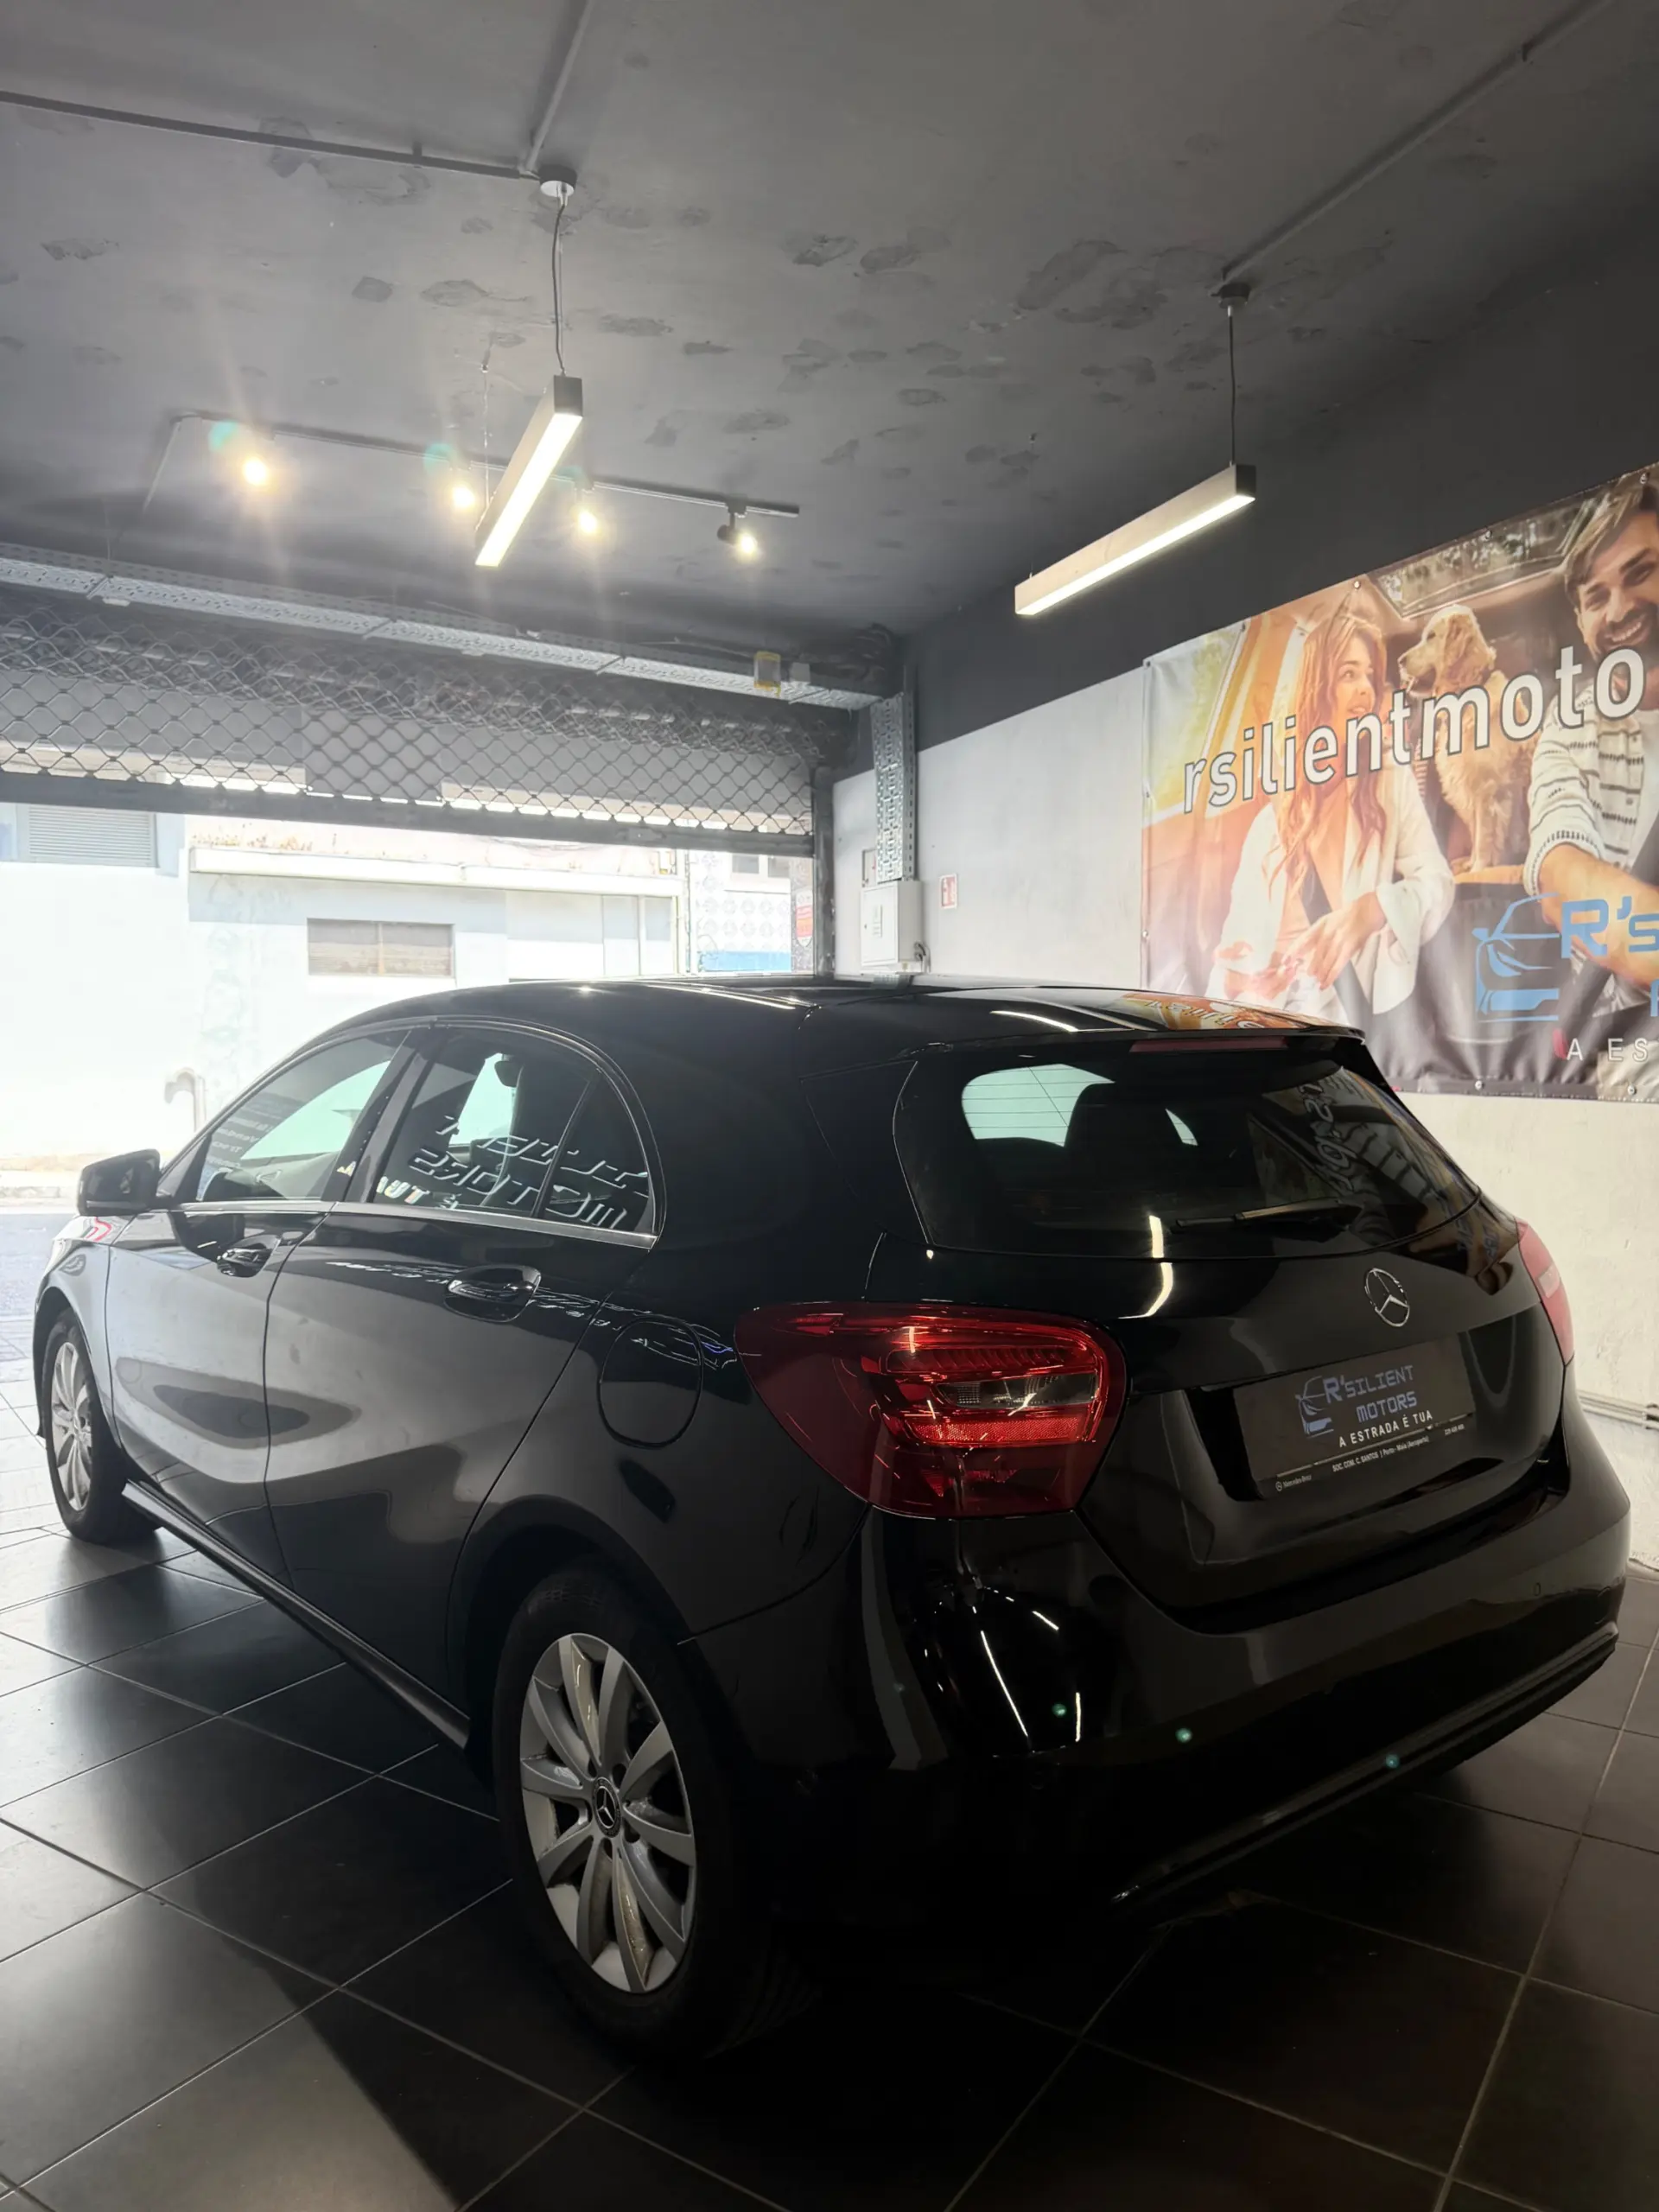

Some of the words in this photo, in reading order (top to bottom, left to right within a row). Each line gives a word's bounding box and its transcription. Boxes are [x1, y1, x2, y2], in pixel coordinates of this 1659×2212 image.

[1567, 1038, 1584, 1061] A
[1356, 1390, 1417, 1423] MOTORS
[1338, 1436, 1347, 1448] A
[1350, 1420, 1400, 1444] ESTRADA
[1402, 1414, 1409, 1427] É
[1412, 1410, 1433, 1425] TUA
